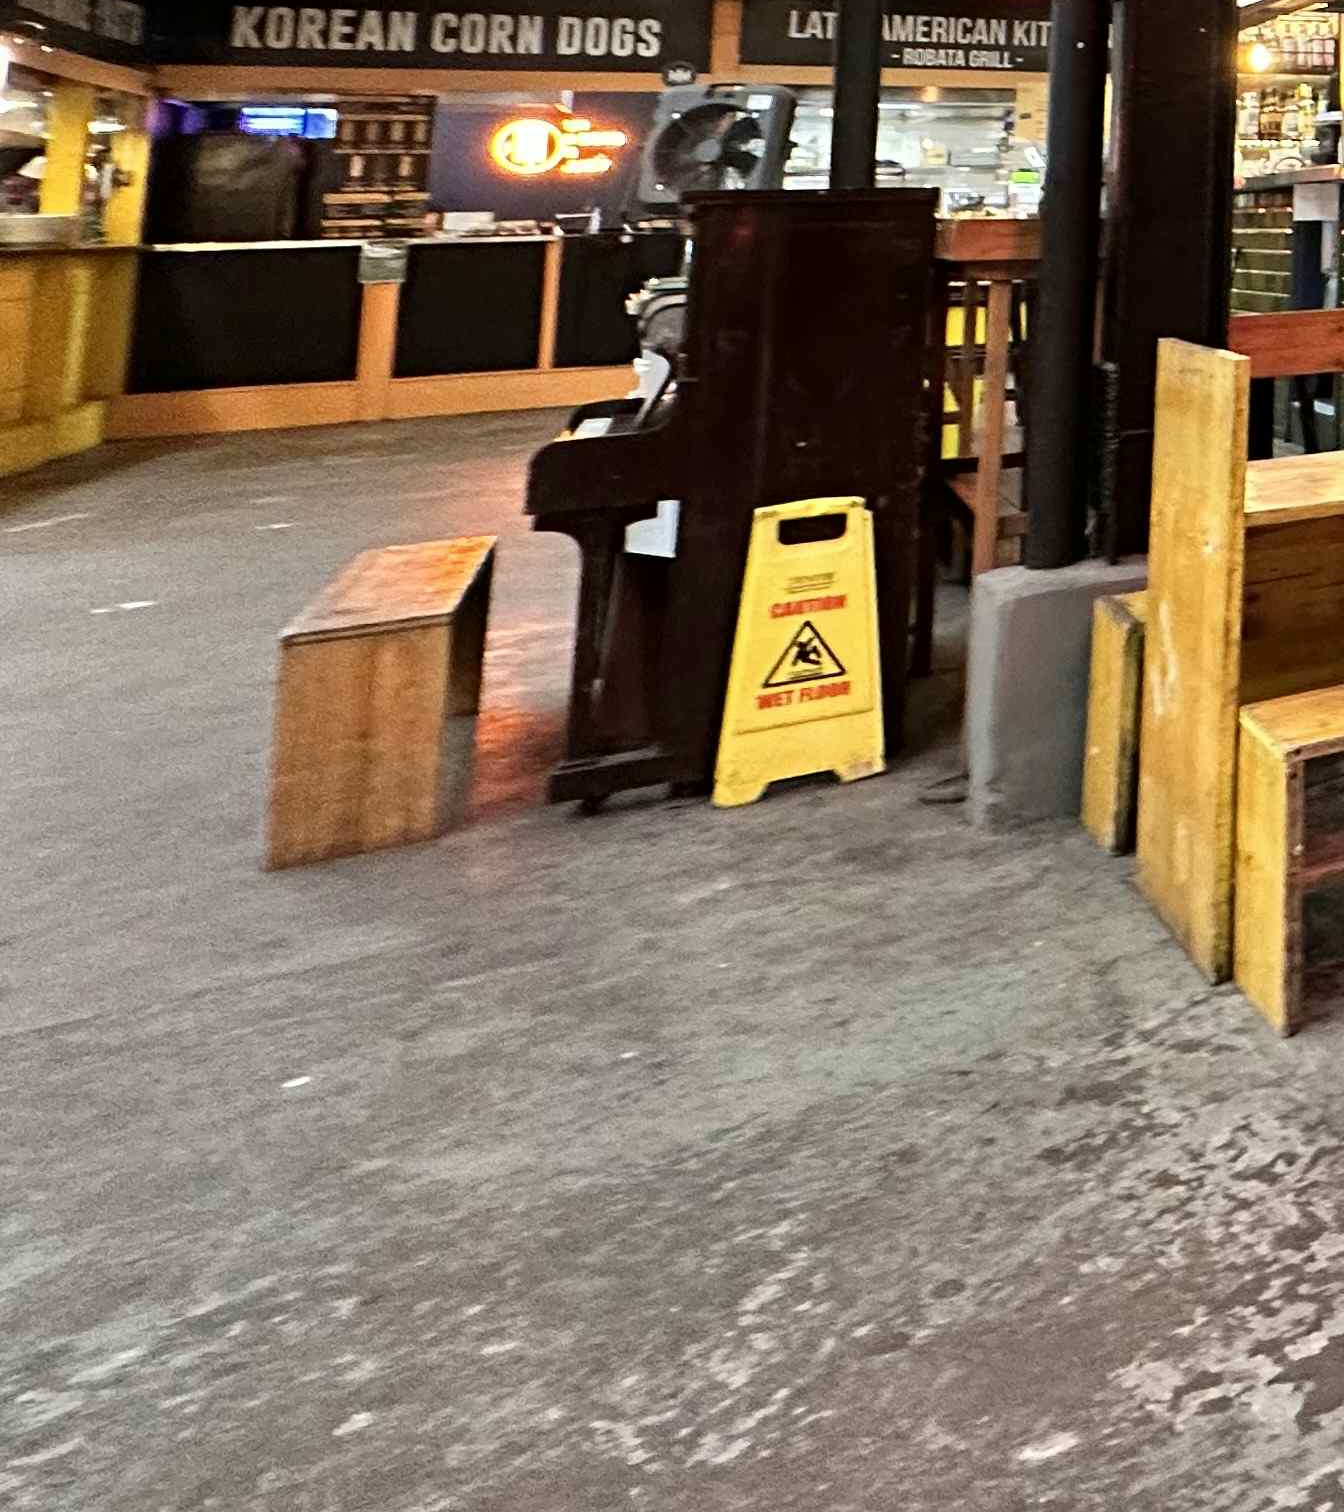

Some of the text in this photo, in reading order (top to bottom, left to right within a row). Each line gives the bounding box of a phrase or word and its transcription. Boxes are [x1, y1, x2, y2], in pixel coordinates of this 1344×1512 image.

[231, 6, 663, 58] KOREAN CORN DOGS
[787, 10, 840, 39] LAT
[903, 48, 966, 67] ROBATA
[969, 50, 1014, 68] GRILL
[757, 690, 794, 710] WET
